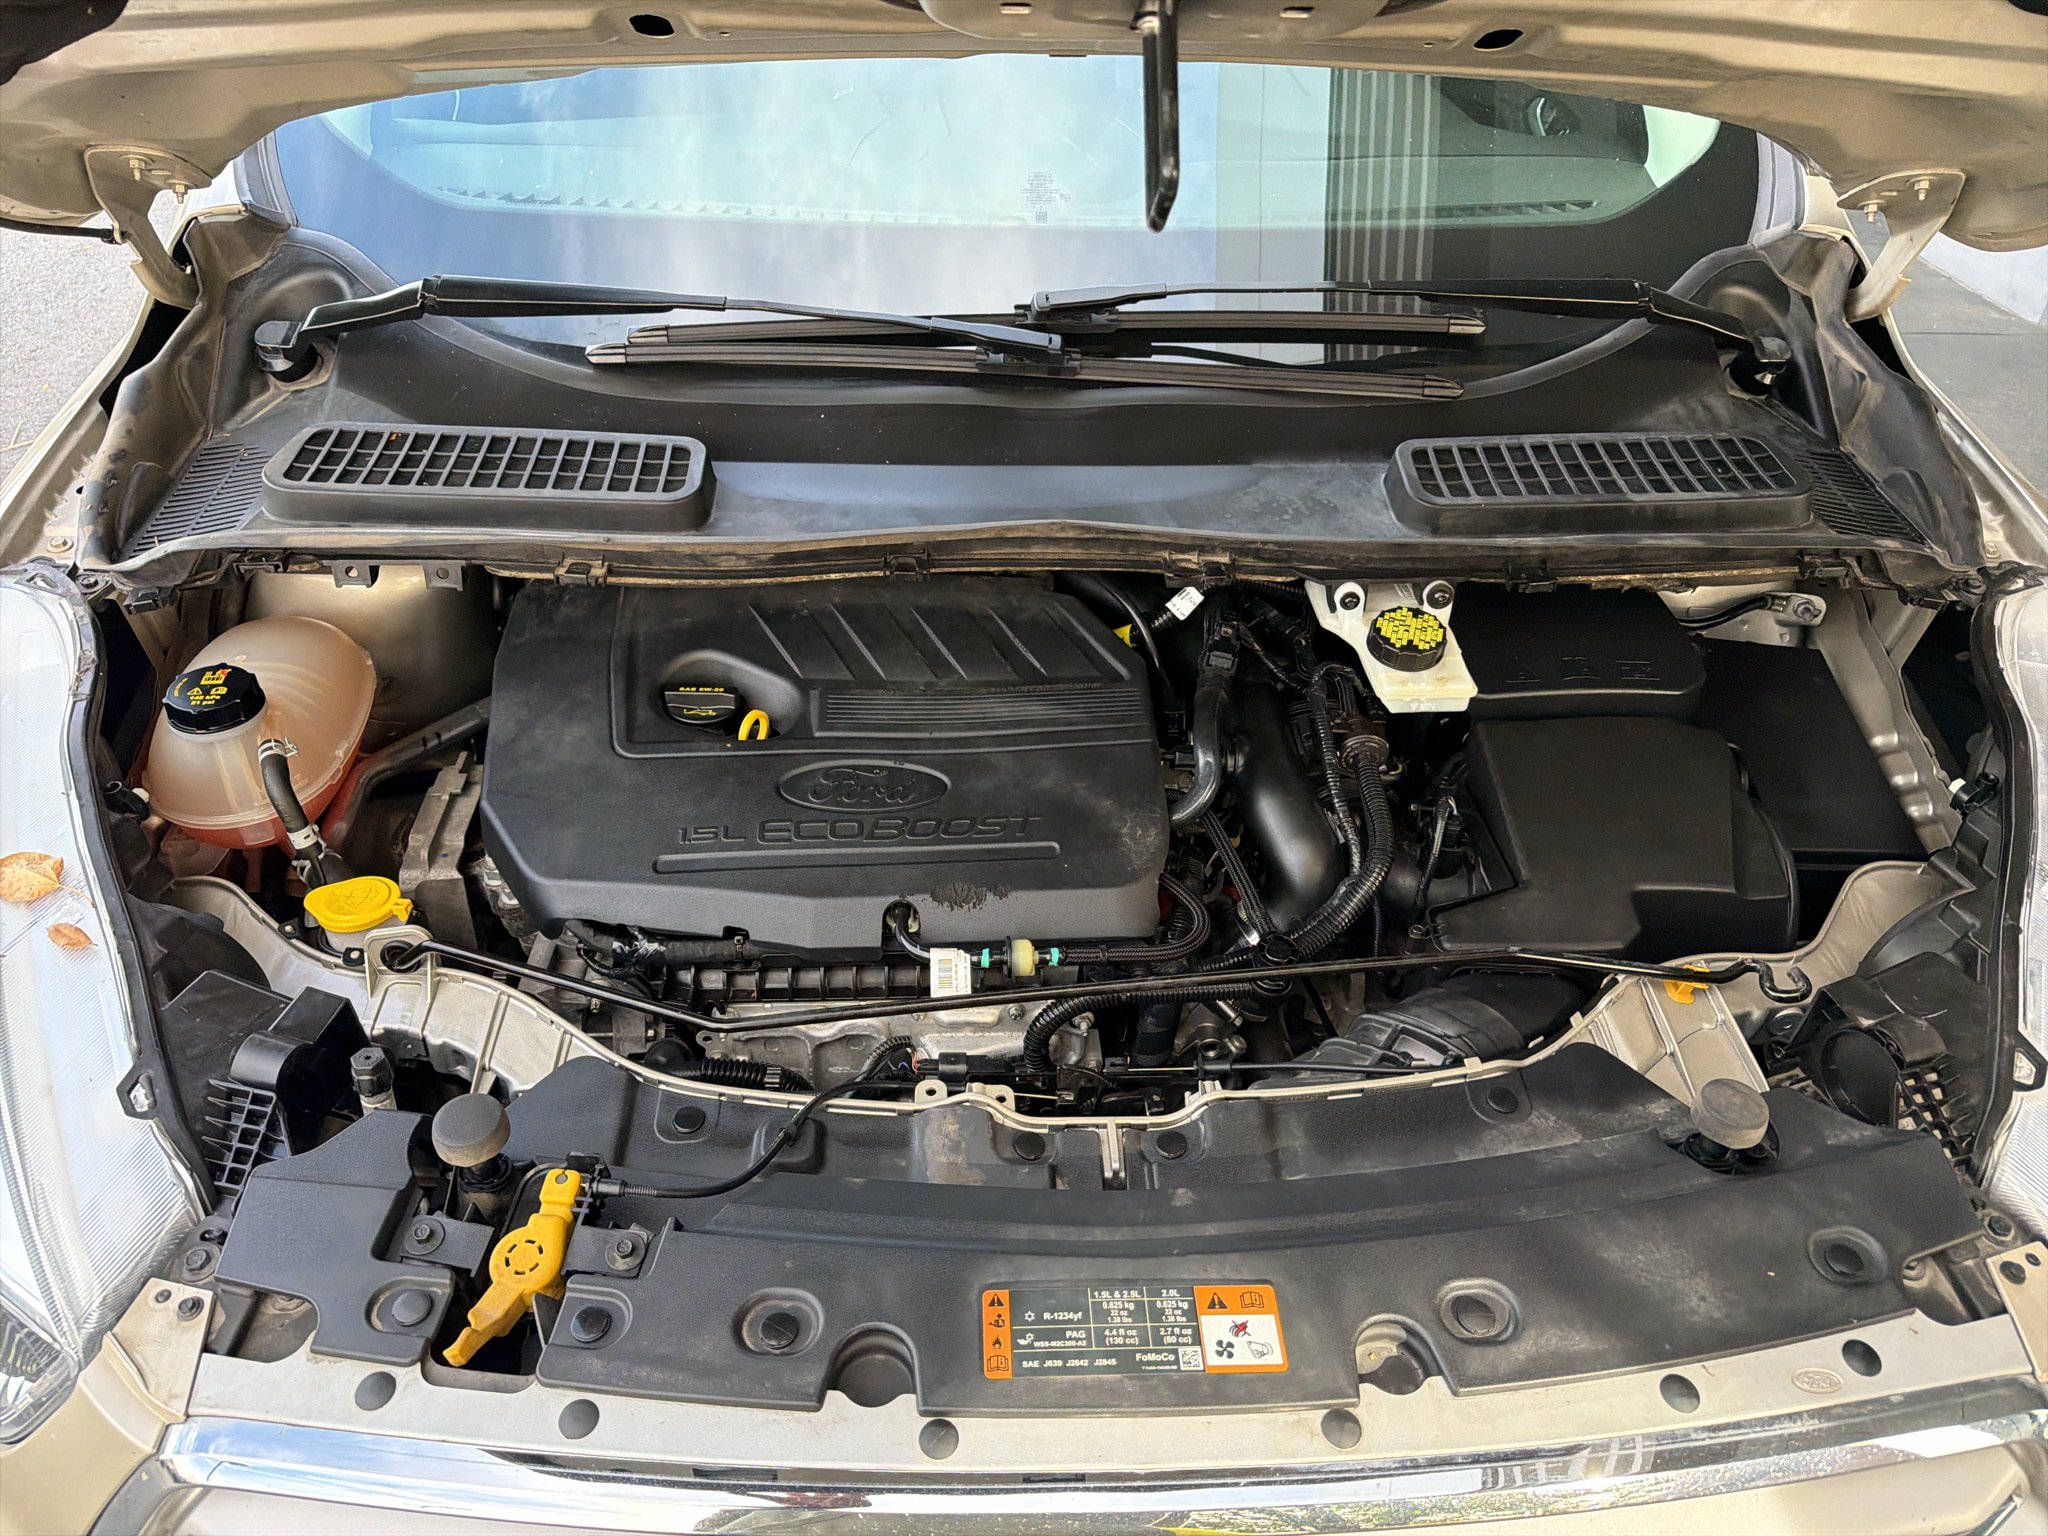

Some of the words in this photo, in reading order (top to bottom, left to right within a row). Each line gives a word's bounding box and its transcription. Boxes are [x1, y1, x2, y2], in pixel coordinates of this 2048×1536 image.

[808, 768, 917, 803] Ford
[1094, 1290, 1112, 1299] 1.5L
[1113, 1290, 1121, 1298] &
[1122, 1290, 1142, 1298] 2.5L
[1161, 1289, 1180, 1297] 2.0L
[1102, 1301, 1123, 1309] 0.625
[1124, 1301, 1135, 1311] kg
[1156, 1300, 1177, 1308] 0.625
[1178, 1300, 1189, 1310] kg
[1043, 1311, 1083, 1321] R-1234yf
[1065, 1330, 1086, 1339] PAG
[1104, 1328, 1117, 1336] 4.4
[1105, 1337, 1124, 1345] (130
[1125, 1337, 1139, 1345] cc)
[1163, 1336, 1178, 1344] (80
[1179, 1336, 1192, 1344] cc)
[1135, 1352, 1175, 1361] FoMoCo
